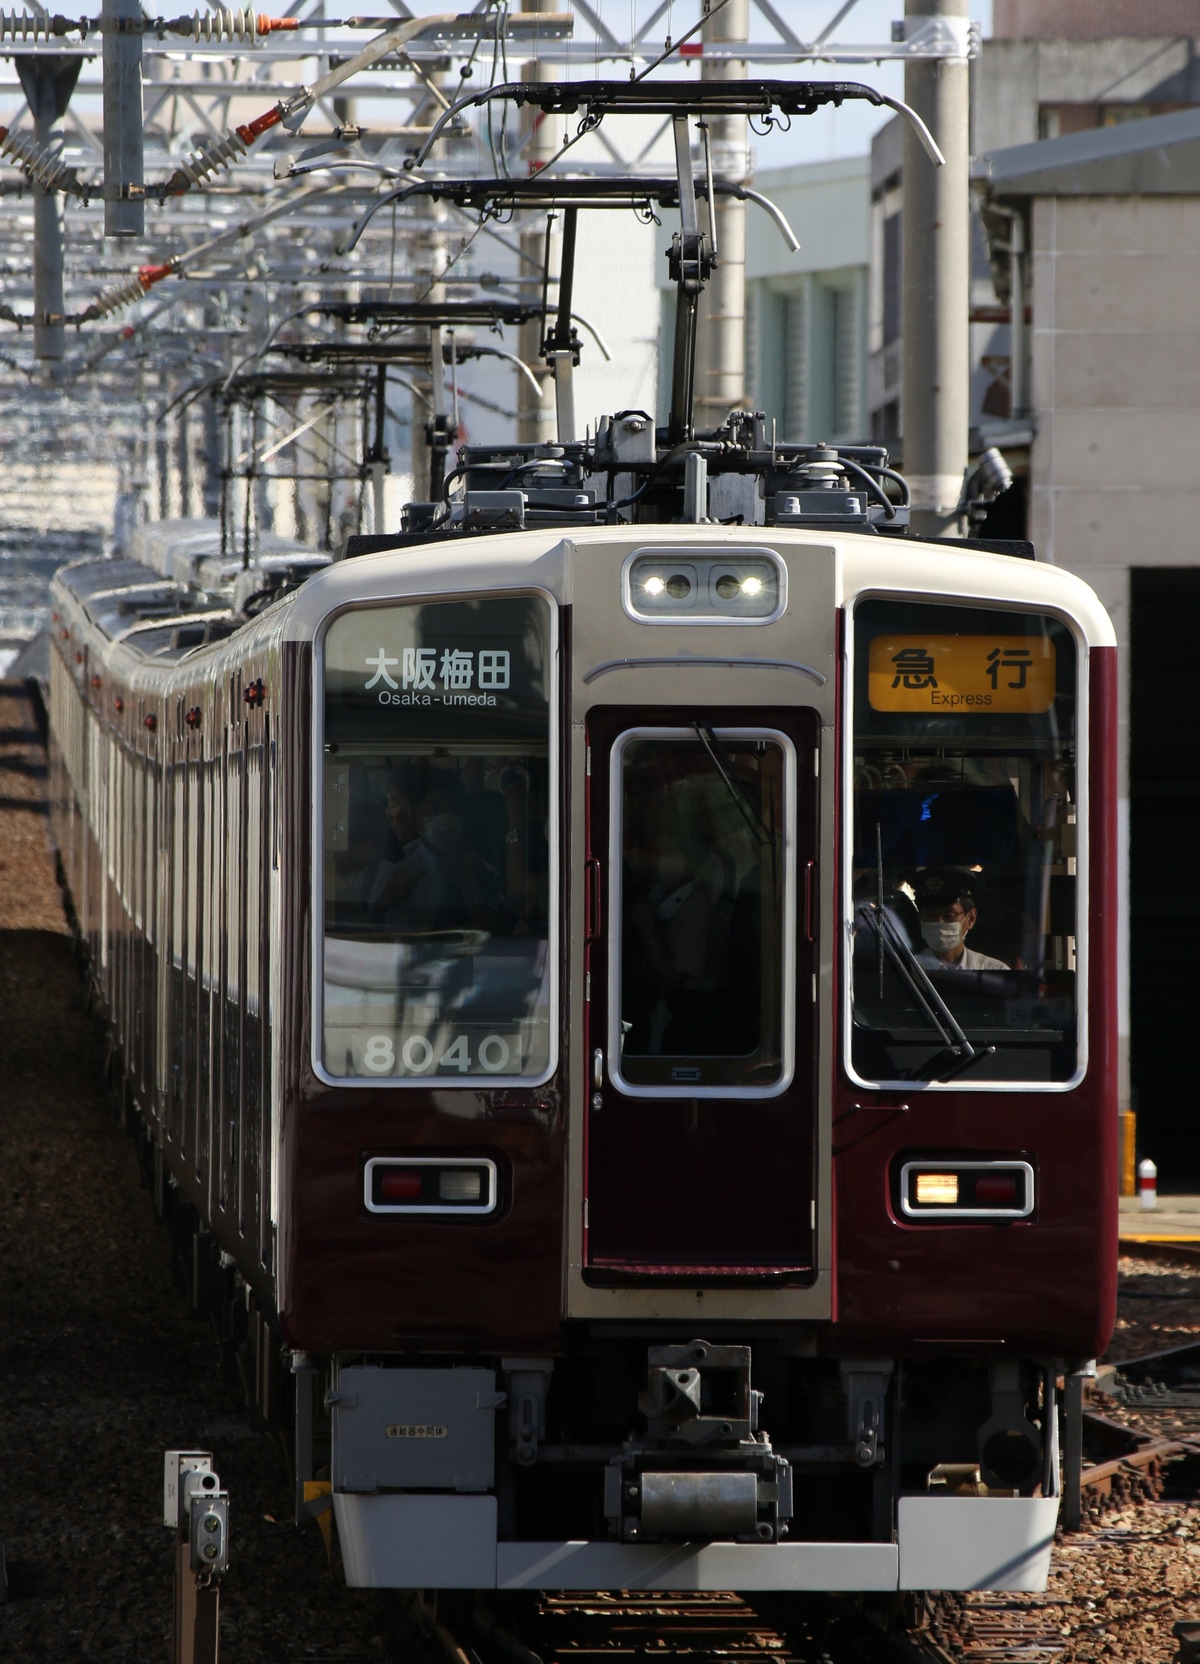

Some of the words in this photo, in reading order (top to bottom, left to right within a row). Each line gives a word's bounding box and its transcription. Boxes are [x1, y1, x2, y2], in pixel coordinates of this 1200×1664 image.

[364, 648, 510, 690] 大阪梅田
[891, 648, 1033, 690] 急行
[378, 691, 497, 706] Osaka-umeda
[931, 691, 993, 707] Express
[364, 1035, 510, 1073] 8040
